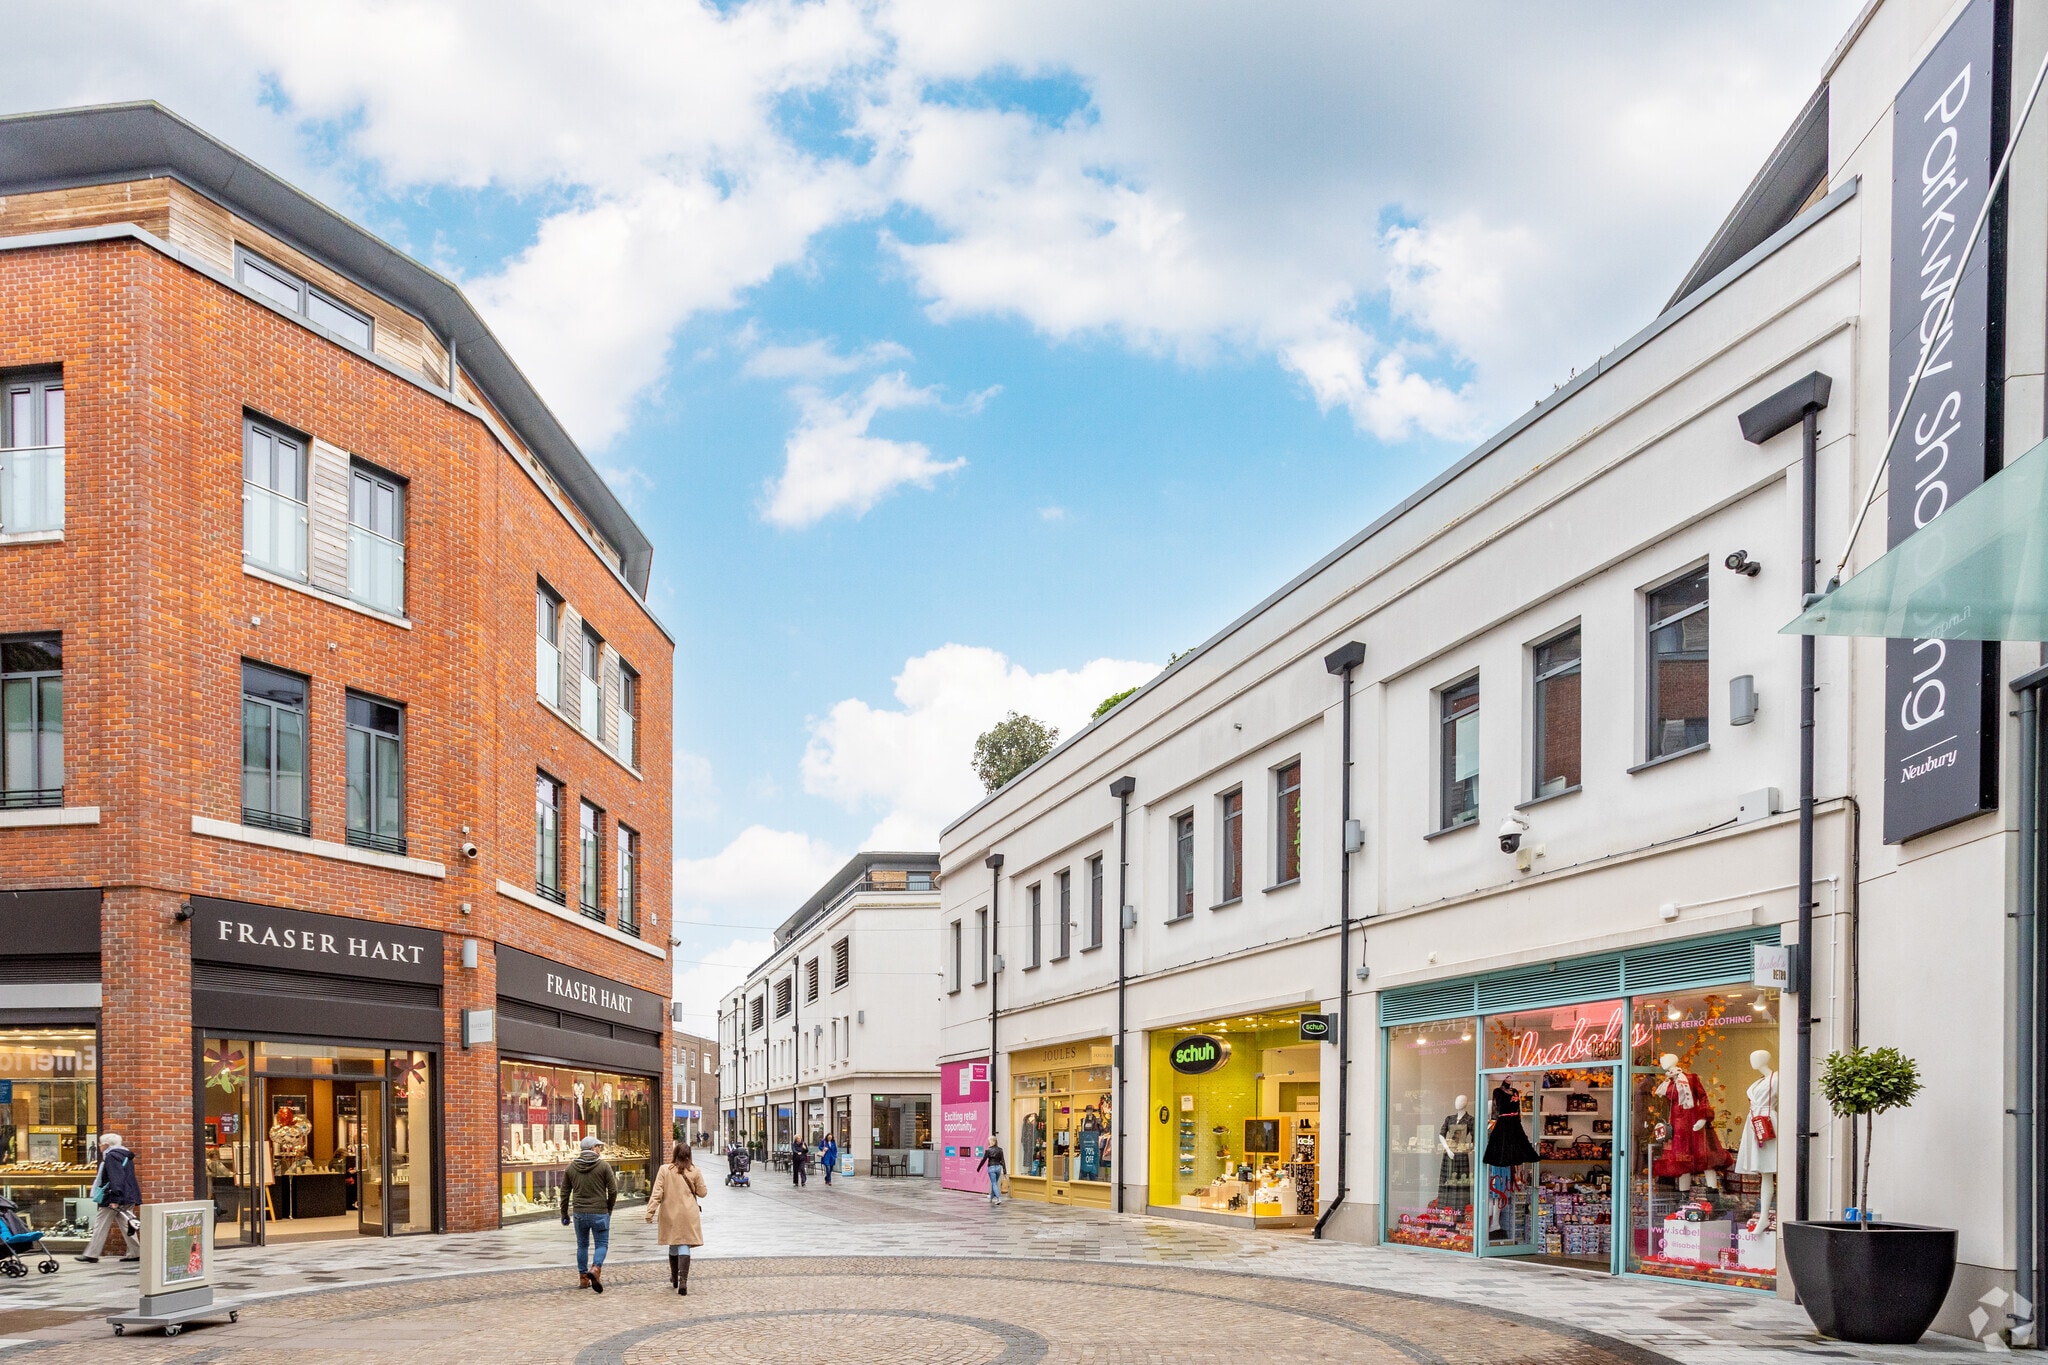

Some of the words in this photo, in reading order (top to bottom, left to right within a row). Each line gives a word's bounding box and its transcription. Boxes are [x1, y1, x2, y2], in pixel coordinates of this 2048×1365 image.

[1909, 62, 1971, 384] Parkway
[1901, 390, 1962, 731] Shoppng
[1900, 749, 1958, 784] Newbury
[217, 920, 339, 954] FRASER
[348, 937, 424, 964] HART
[546, 973, 598, 1005] FRASER
[600, 989, 633, 1014] HART
[1305, 1023, 1325, 1031] schuh
[1655, 1021, 1679, 1031] MEN'S
[1681, 1019, 1706, 1029] RETRO
[1707, 1014, 1753, 1027] CLOTHING
[1506, 1007, 1654, 1068] Isabels
[1043, 1046, 1076, 1062] JOULES
[1176, 1043, 1215, 1063] schuh
[1591, 1040, 1622, 1058] RETRO
[944, 1111, 963, 1123] Exciting
[963, 1109, 977, 1121] retail
[944, 1122, 977, 1133] opportunity...
[1296, 1134, 1315, 1145] kids
[1085, 1147, 1095, 1155] 70%
[1085, 1155, 1094, 1164] OFF
